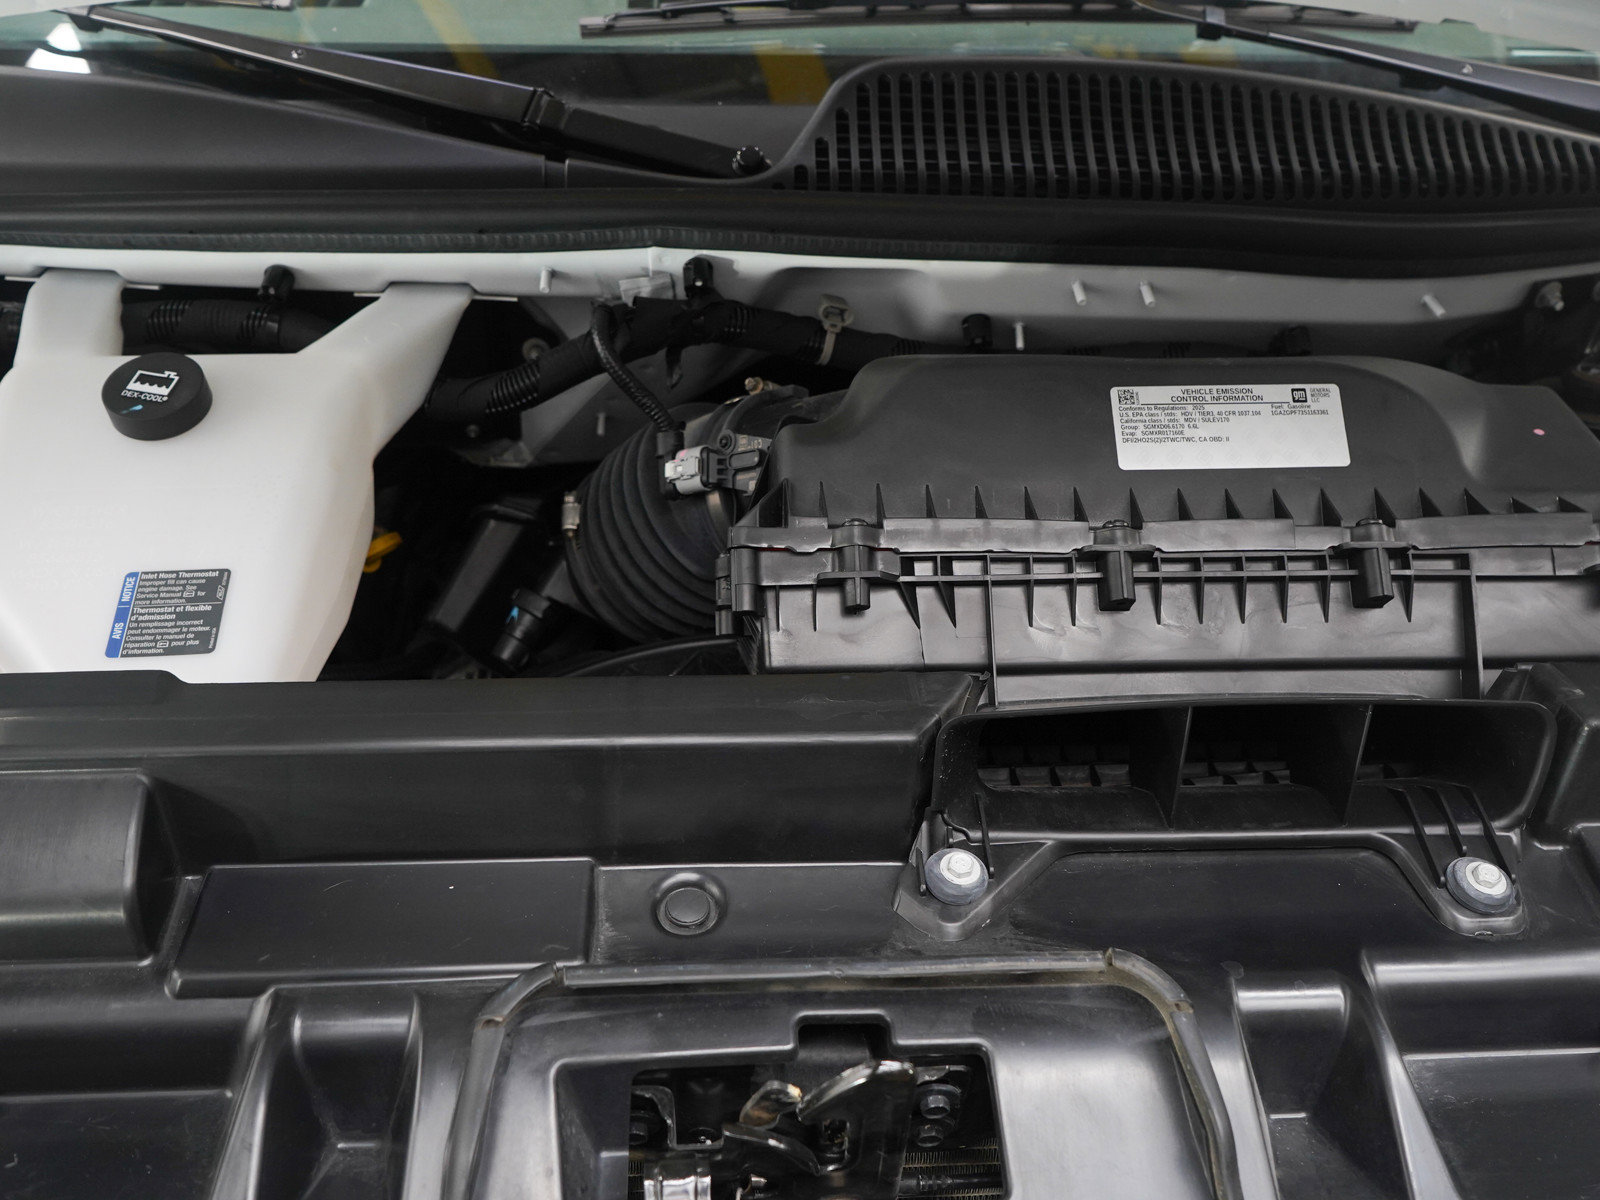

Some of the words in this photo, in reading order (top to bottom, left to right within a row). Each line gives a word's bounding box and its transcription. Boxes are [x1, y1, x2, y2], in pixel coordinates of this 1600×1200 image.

[1293, 390, 1306, 400] gm
[121, 576, 135, 602] NOTICE
[112, 622, 124, 639] AVIS
